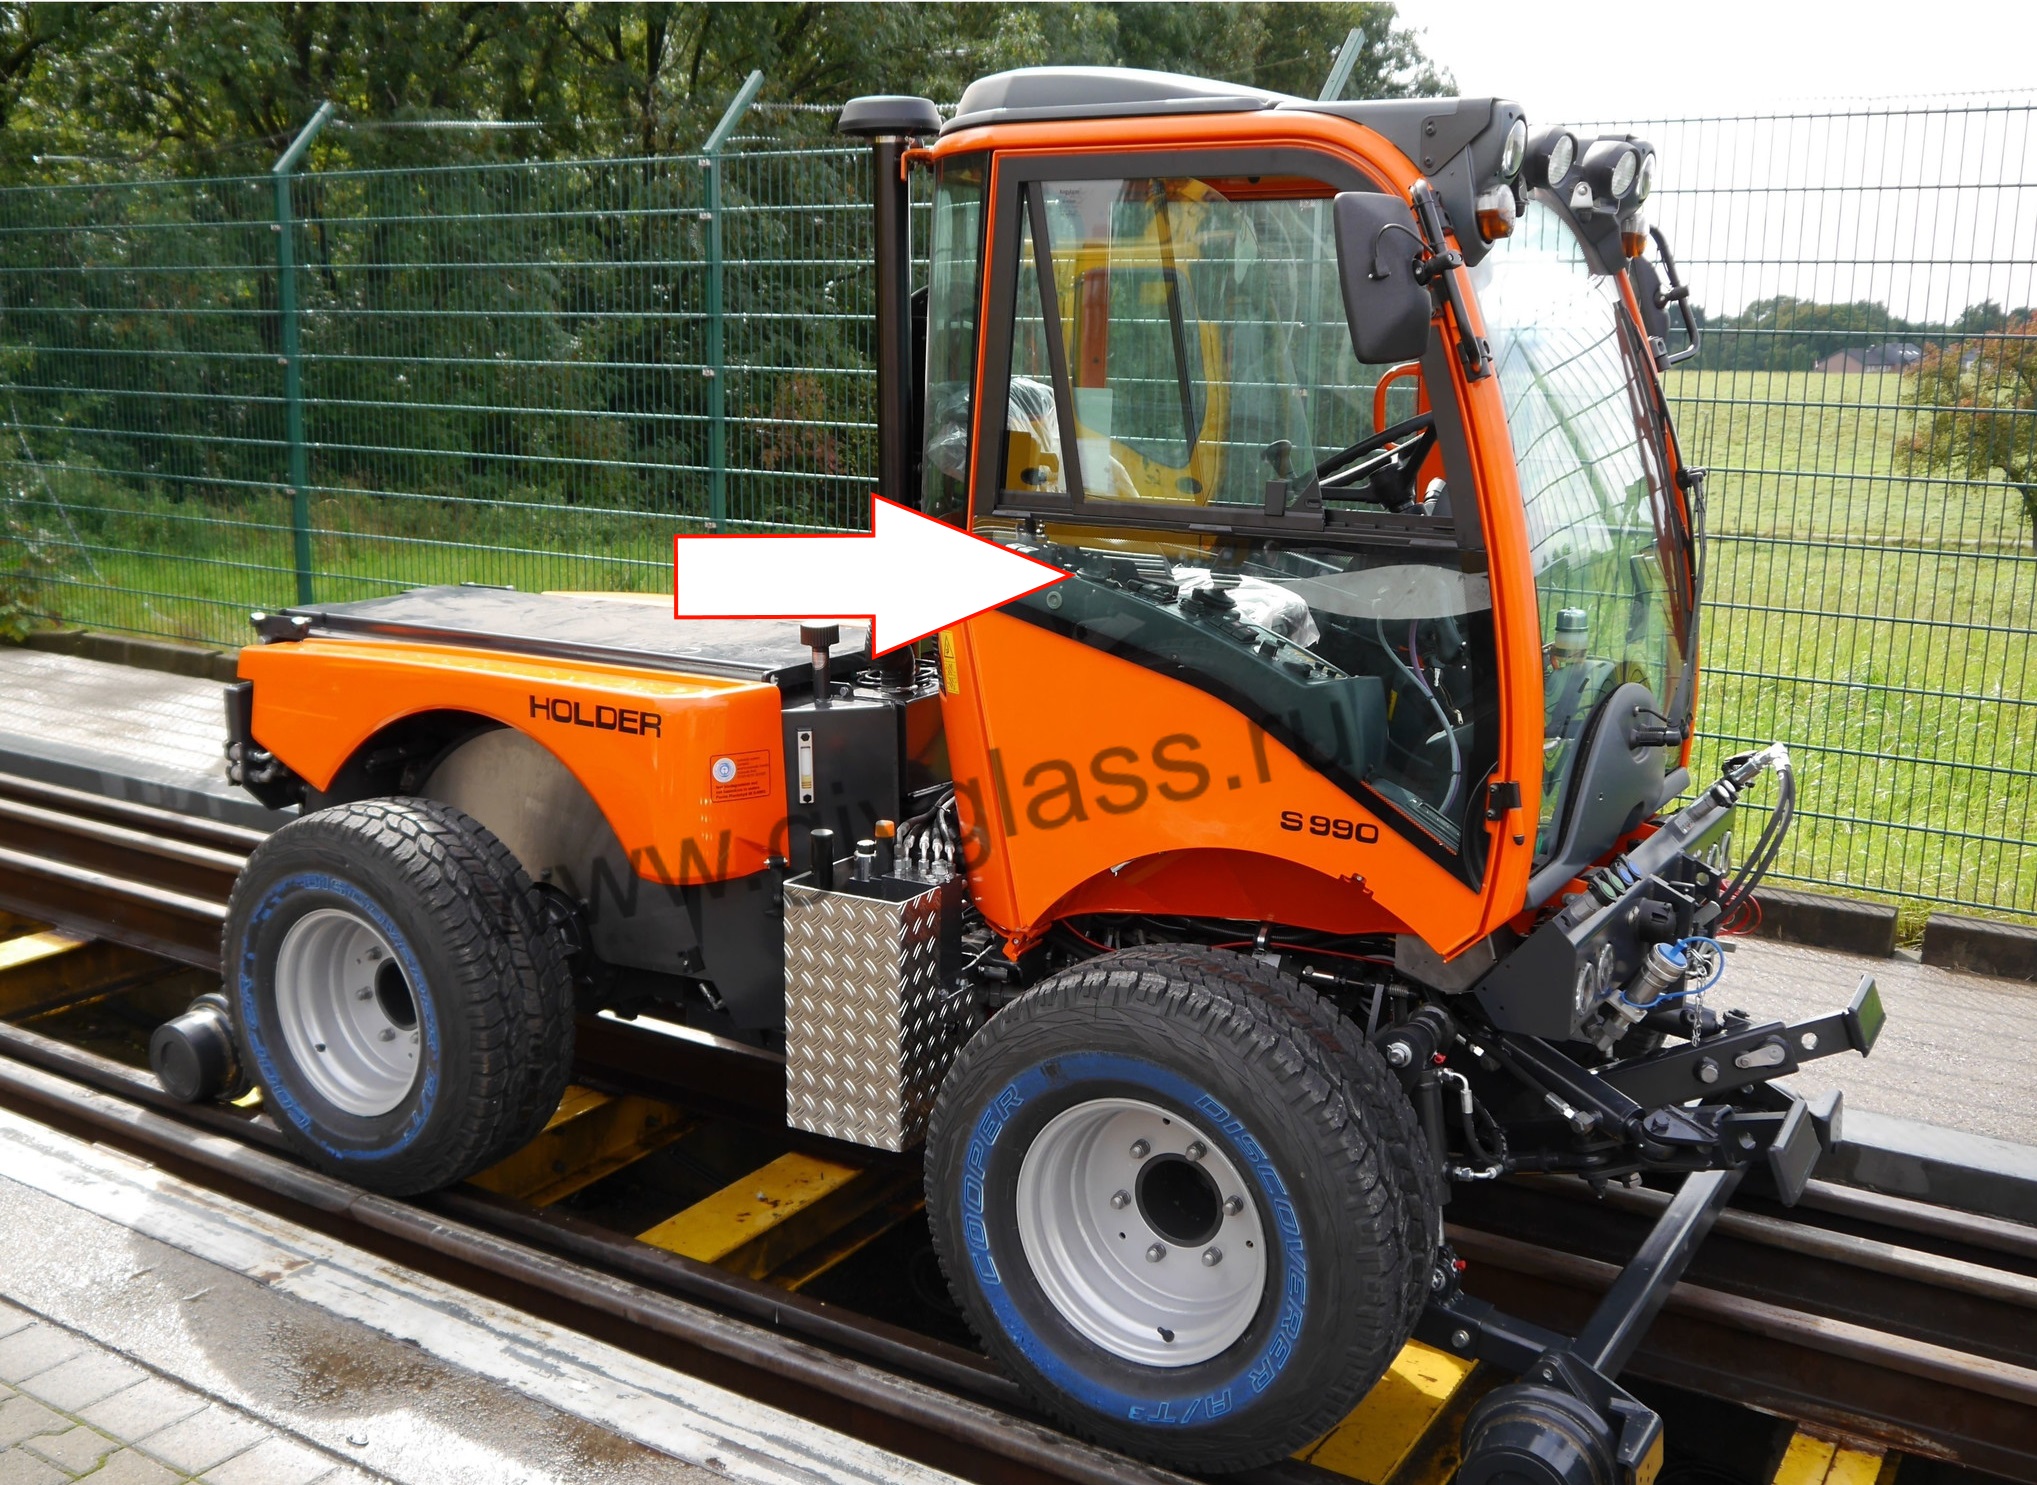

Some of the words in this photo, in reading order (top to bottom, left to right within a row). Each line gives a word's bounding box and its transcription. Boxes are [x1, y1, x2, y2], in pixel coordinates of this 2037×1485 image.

[529, 695, 662, 738] HOLDER
[1280, 810, 1303, 832] S
[1309, 815, 1379, 844] 990
[964, 1083, 1025, 1285] COOPER
[1195, 1094, 1306, 1394] DISCOVERER
